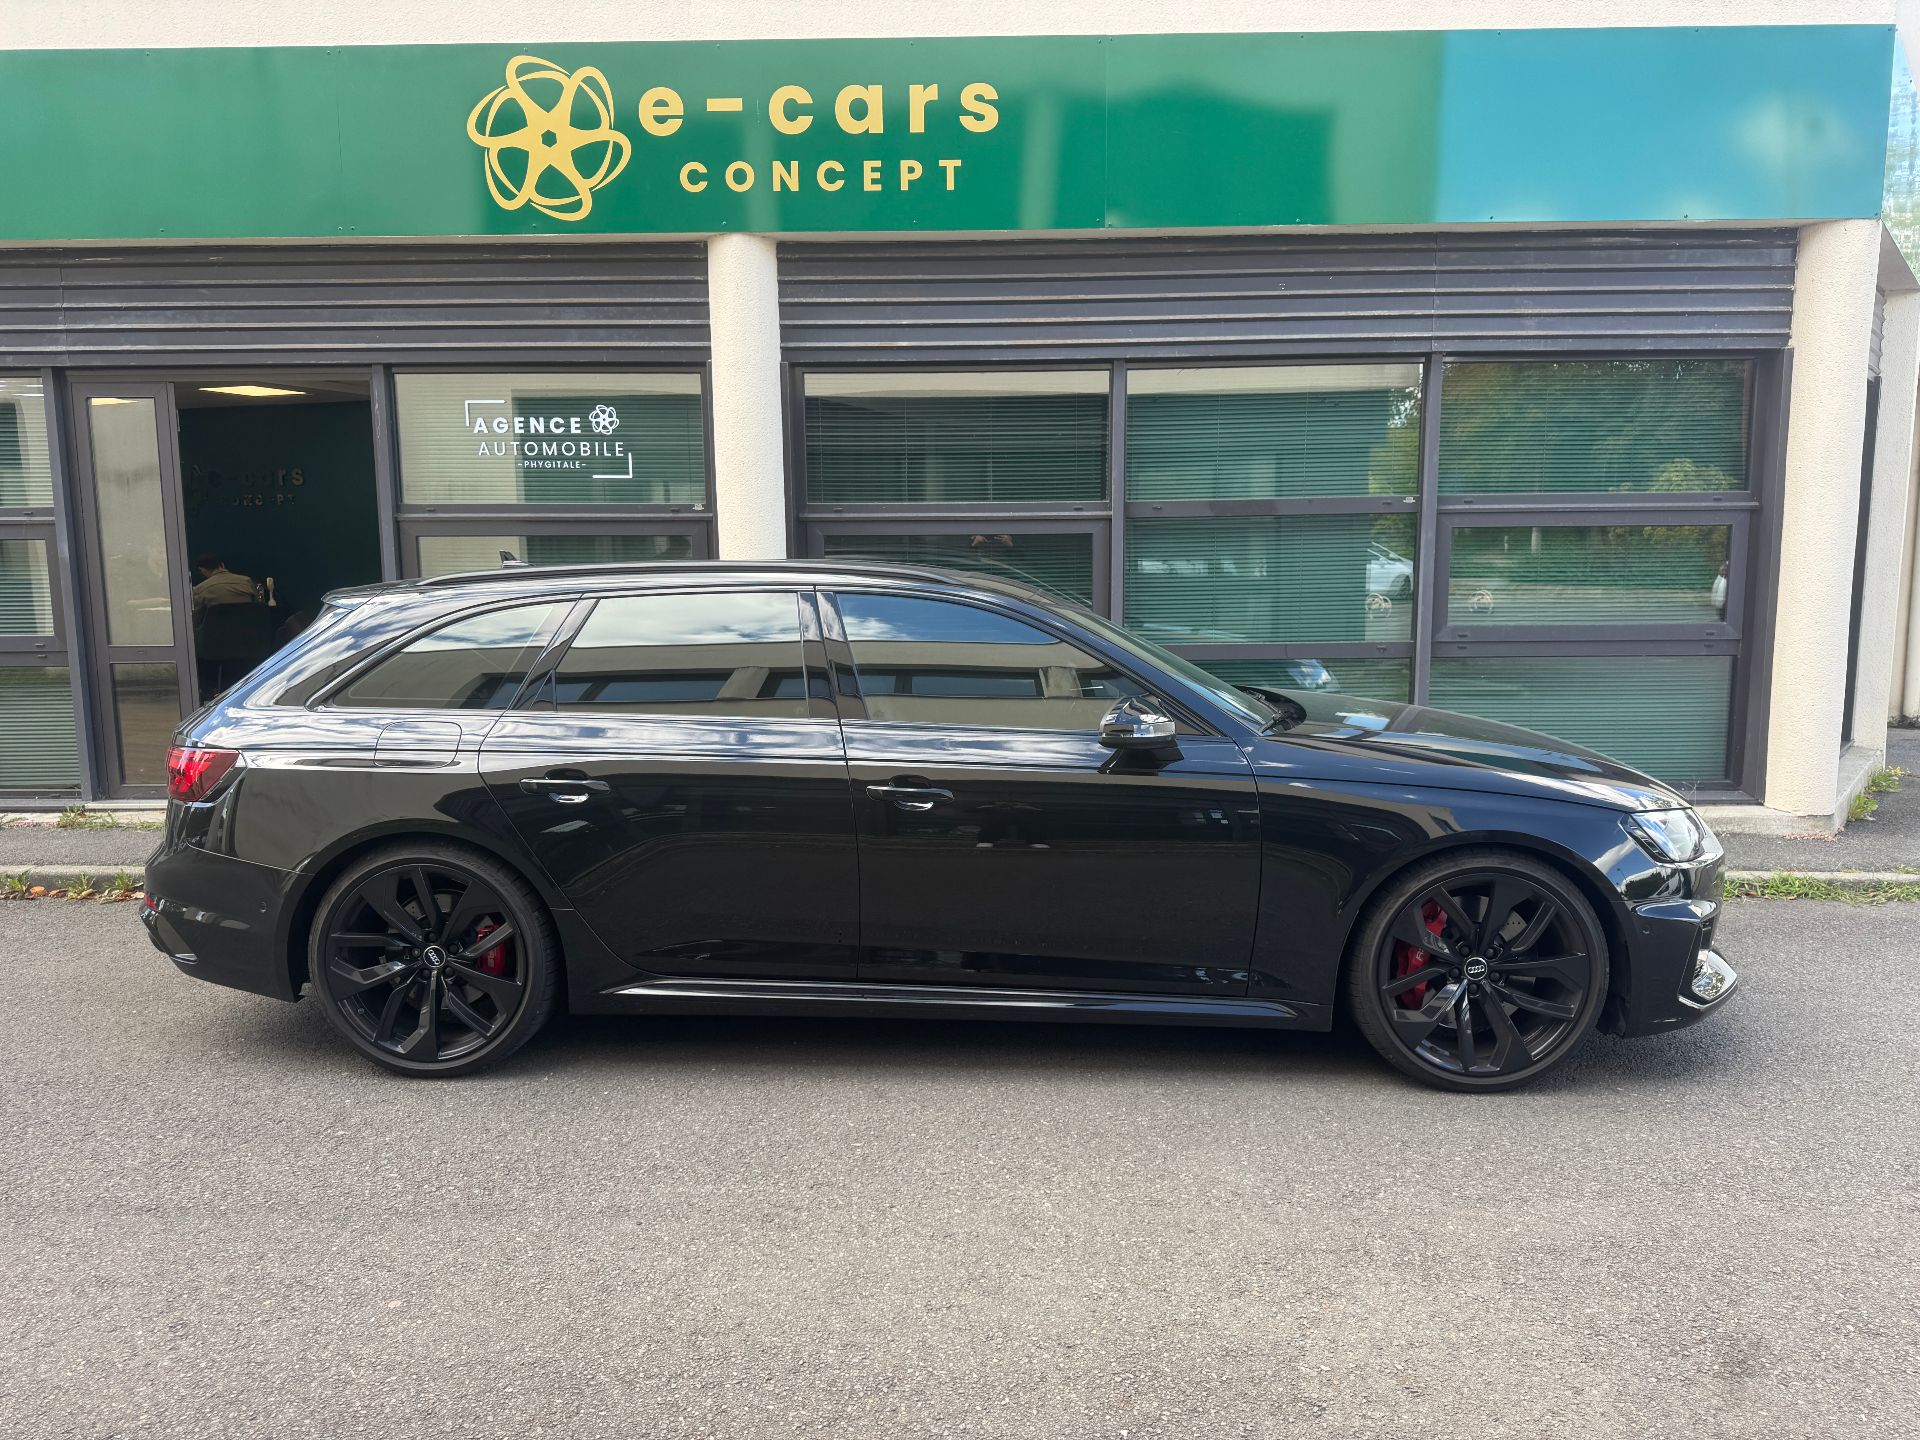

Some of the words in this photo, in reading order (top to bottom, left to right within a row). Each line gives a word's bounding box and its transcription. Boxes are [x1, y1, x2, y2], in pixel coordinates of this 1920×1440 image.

[638, 82, 1000, 136] e-cars
[679, 159, 963, 193] CONCEPT
[473, 417, 583, 434] AGENCE
[478, 441, 625, 457] AUTOMOBILE
